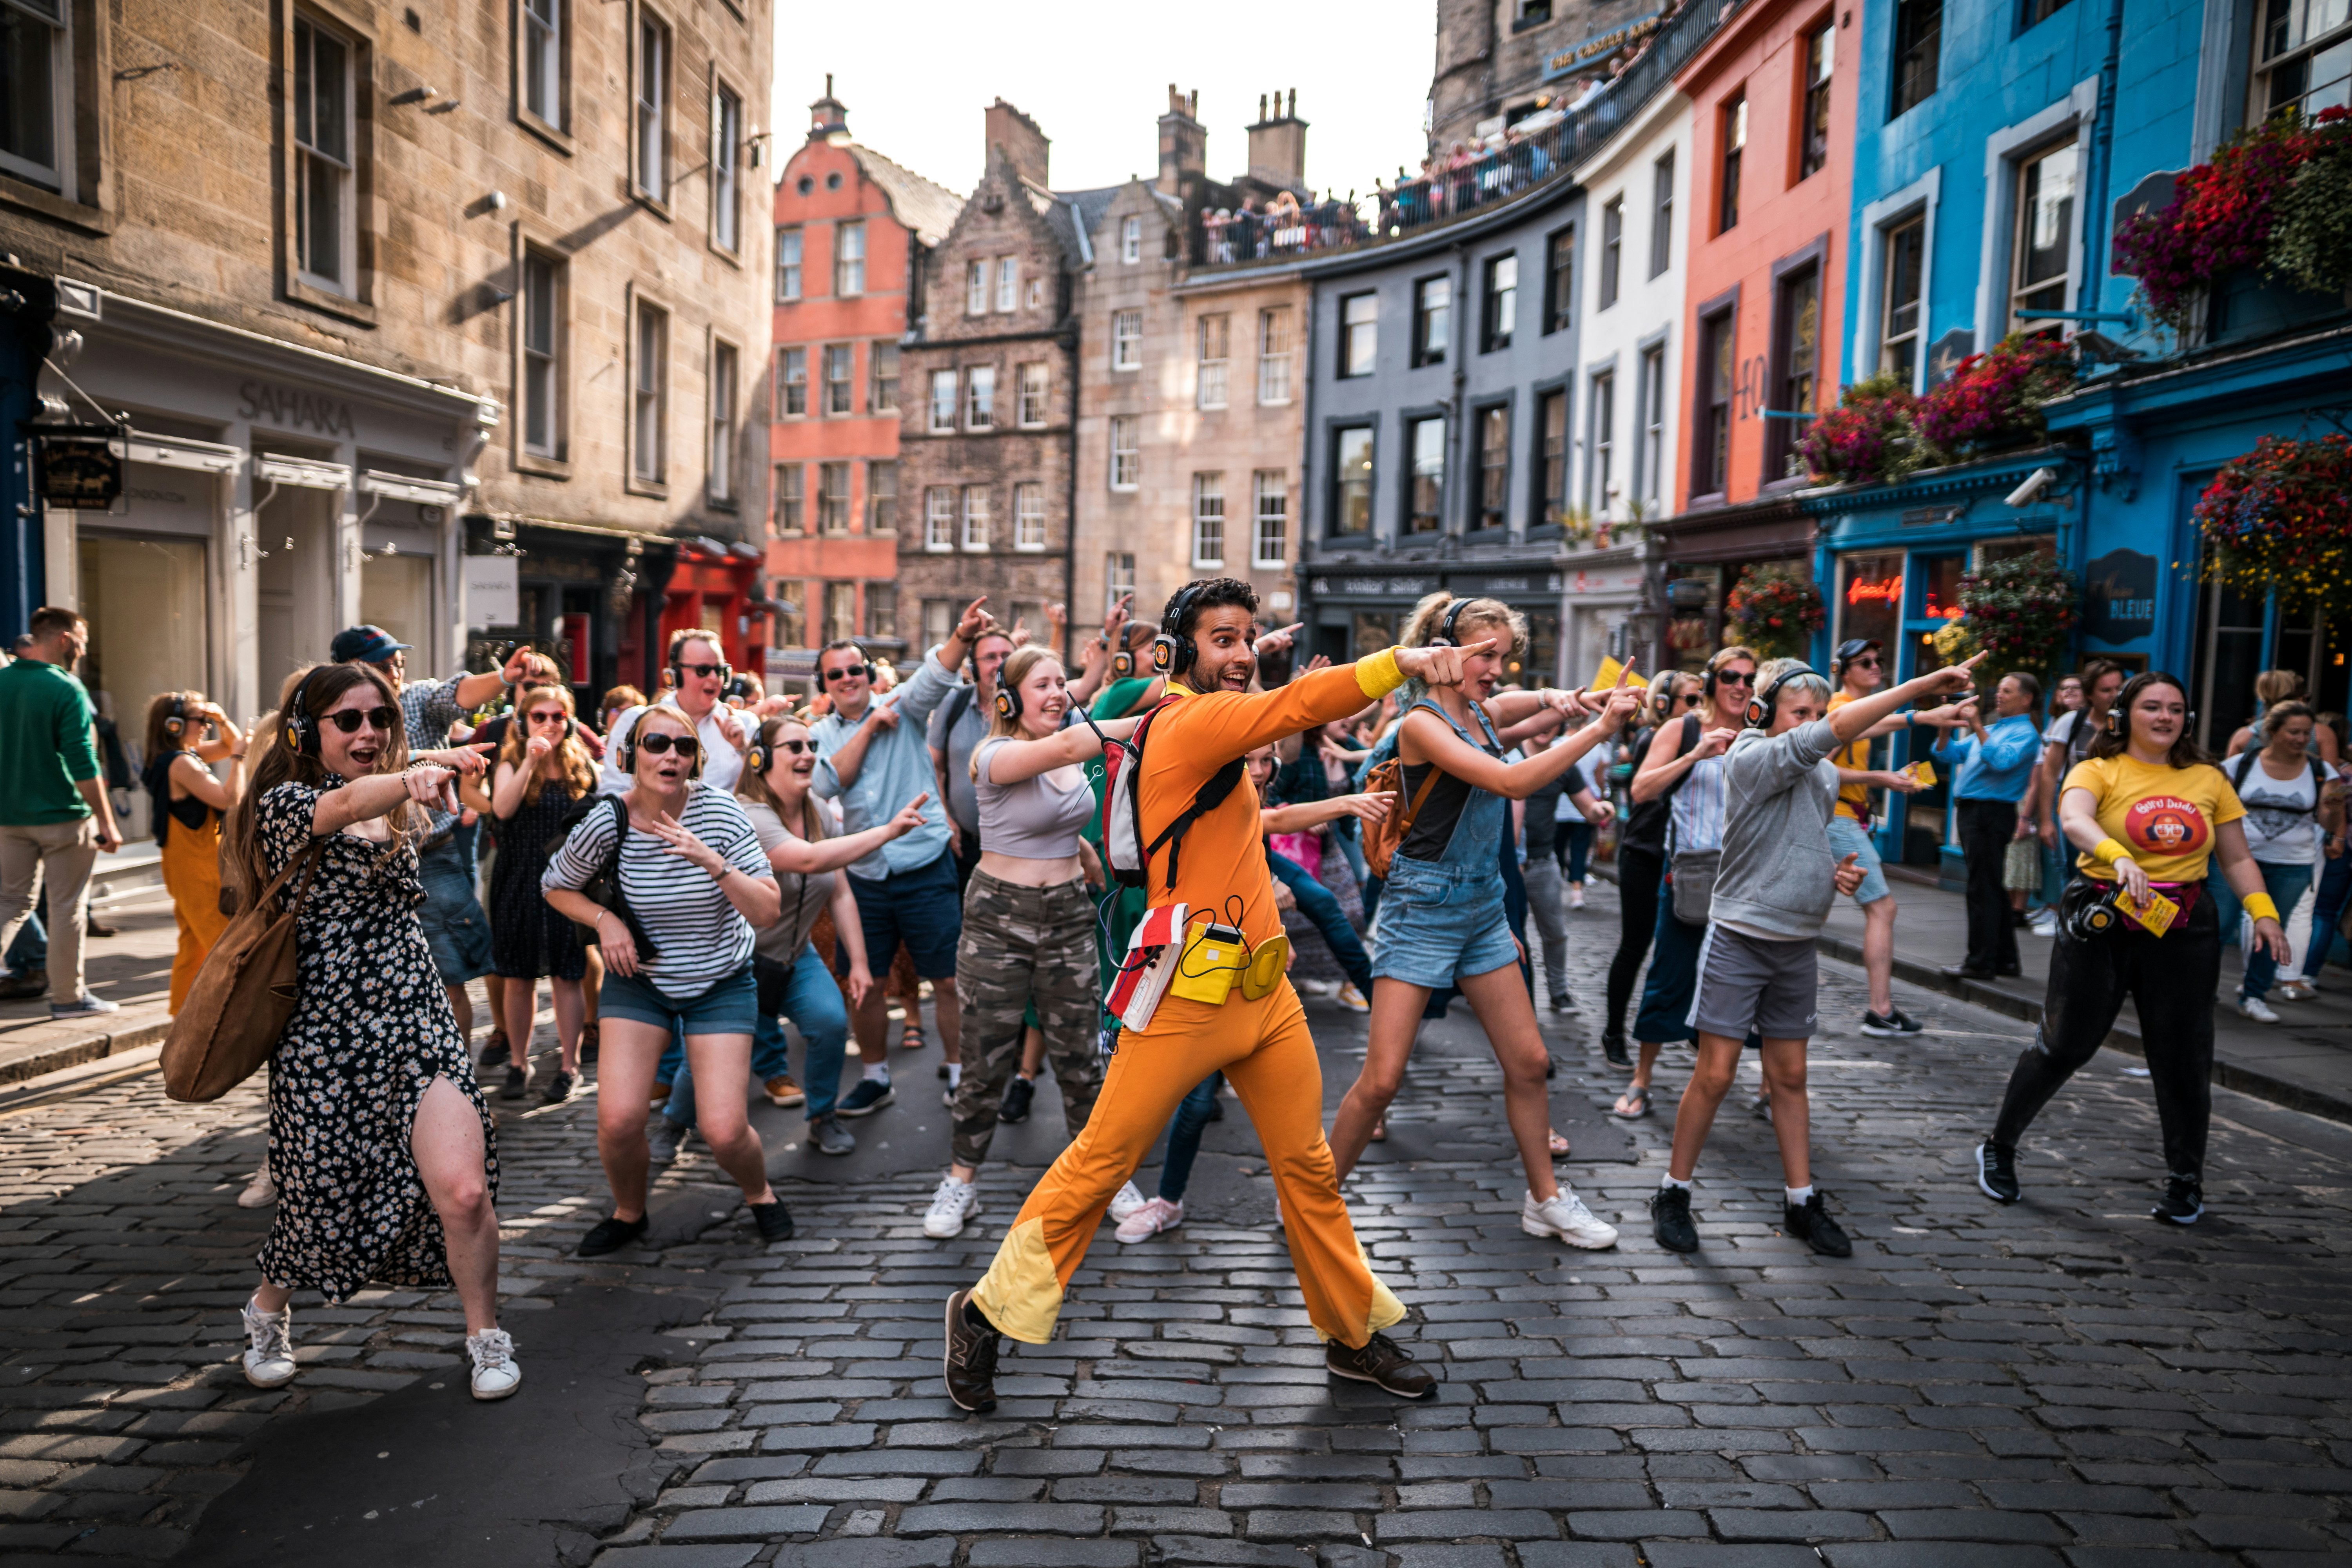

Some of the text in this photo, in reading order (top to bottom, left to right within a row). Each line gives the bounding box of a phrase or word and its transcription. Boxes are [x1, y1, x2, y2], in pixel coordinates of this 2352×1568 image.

[238, 380, 355, 439] SAHARA
[470, 580, 511, 590] SAHARA
[2111, 599, 2153, 619] BLEUE
[2136, 798, 2196, 814] Guru Dudu
